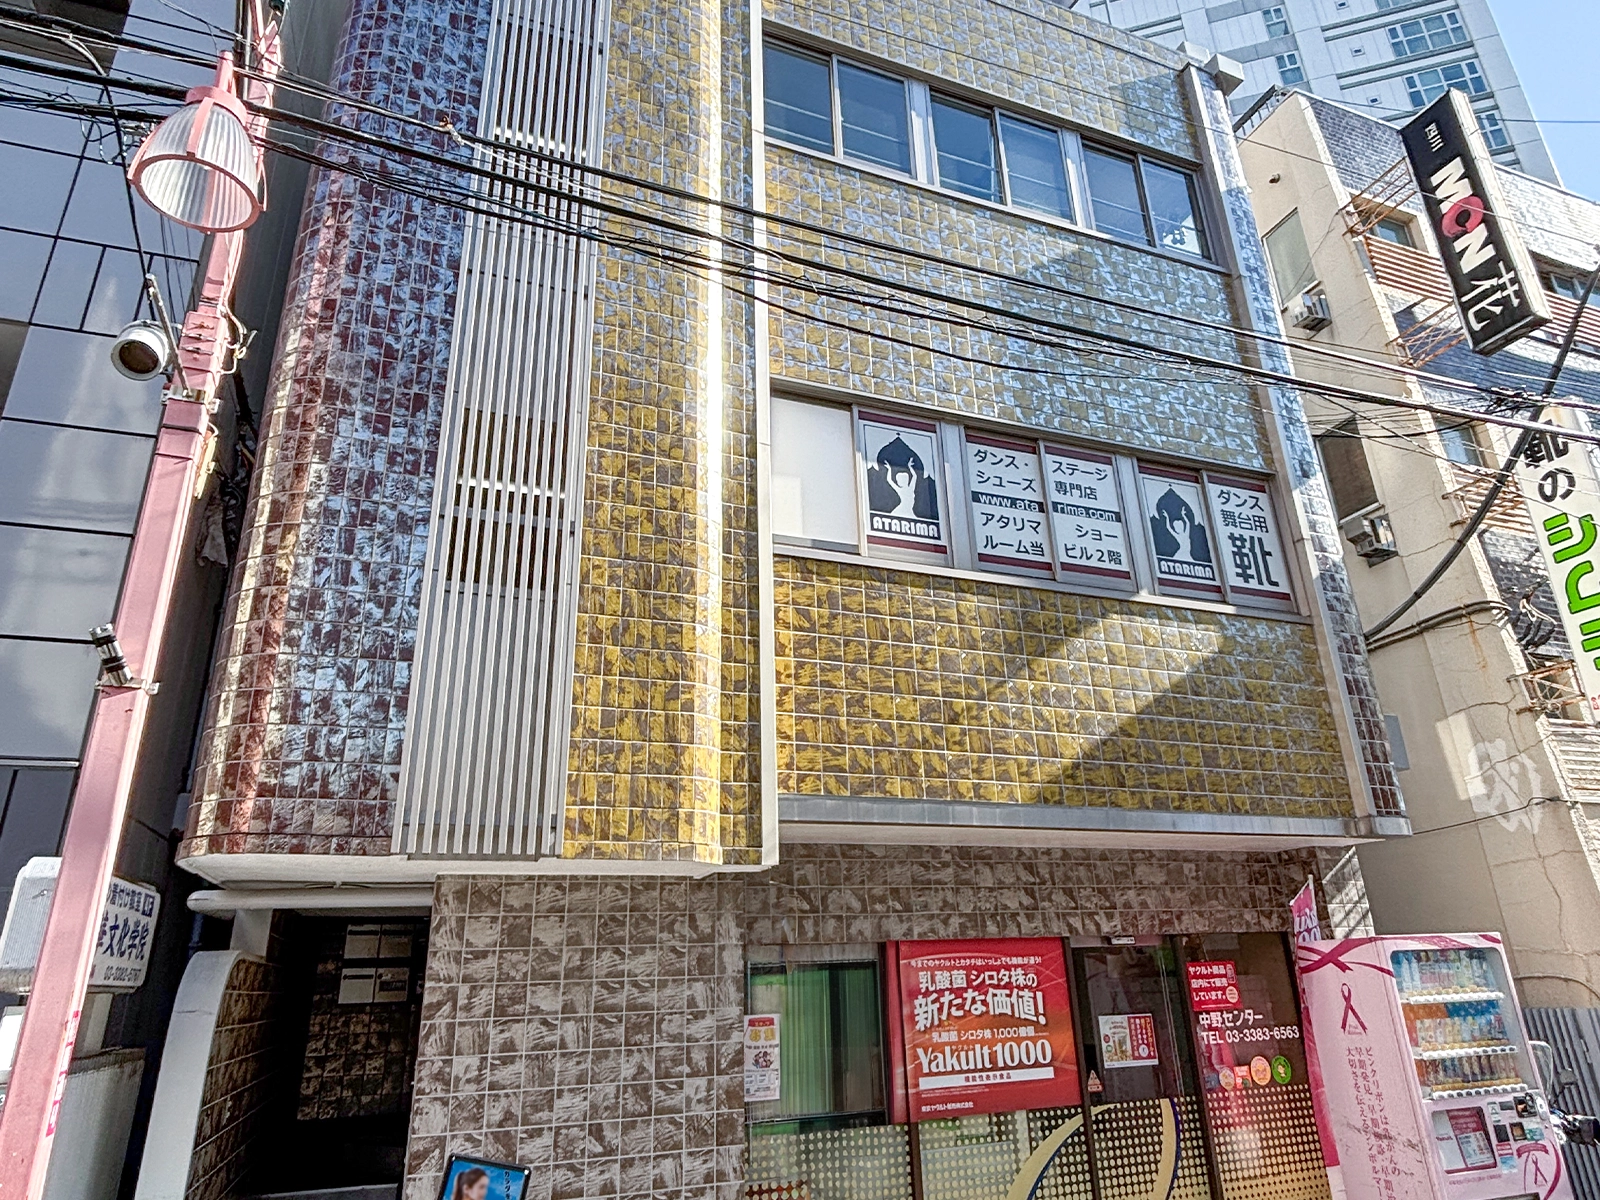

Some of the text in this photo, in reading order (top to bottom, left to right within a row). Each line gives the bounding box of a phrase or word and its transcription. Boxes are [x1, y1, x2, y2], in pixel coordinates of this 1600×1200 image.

[1425, 122, 1444, 152] 四川
[1052, 460, 1108, 481] ステージ
[976, 470, 1098, 501] シューズ 専門店
[978, 493, 1116, 522] www.ata rima.com
[1218, 489, 1265, 512] ダンス
[872, 516, 939, 537] ATARIMA
[980, 512, 1119, 542] アタリマ ショー
[1220, 509, 1269, 534] 舞台用
[983, 535, 1045, 557] ルーム当
[1160, 560, 1214, 579] ATARIMA
[1227, 532, 1280, 587] 靴
[919, 967, 1038, 992] 乳酸菌 シロタ株の
[914, 988, 1046, 1031] 新たな価値!
[1199, 1008, 1263, 1028] 中野センター
[960, 1029, 992, 1040] シロタ株
[1201, 1026, 1300, 1045] TEL 03-3383-6563
[916, 1039, 1052, 1073] Yakult 1000
